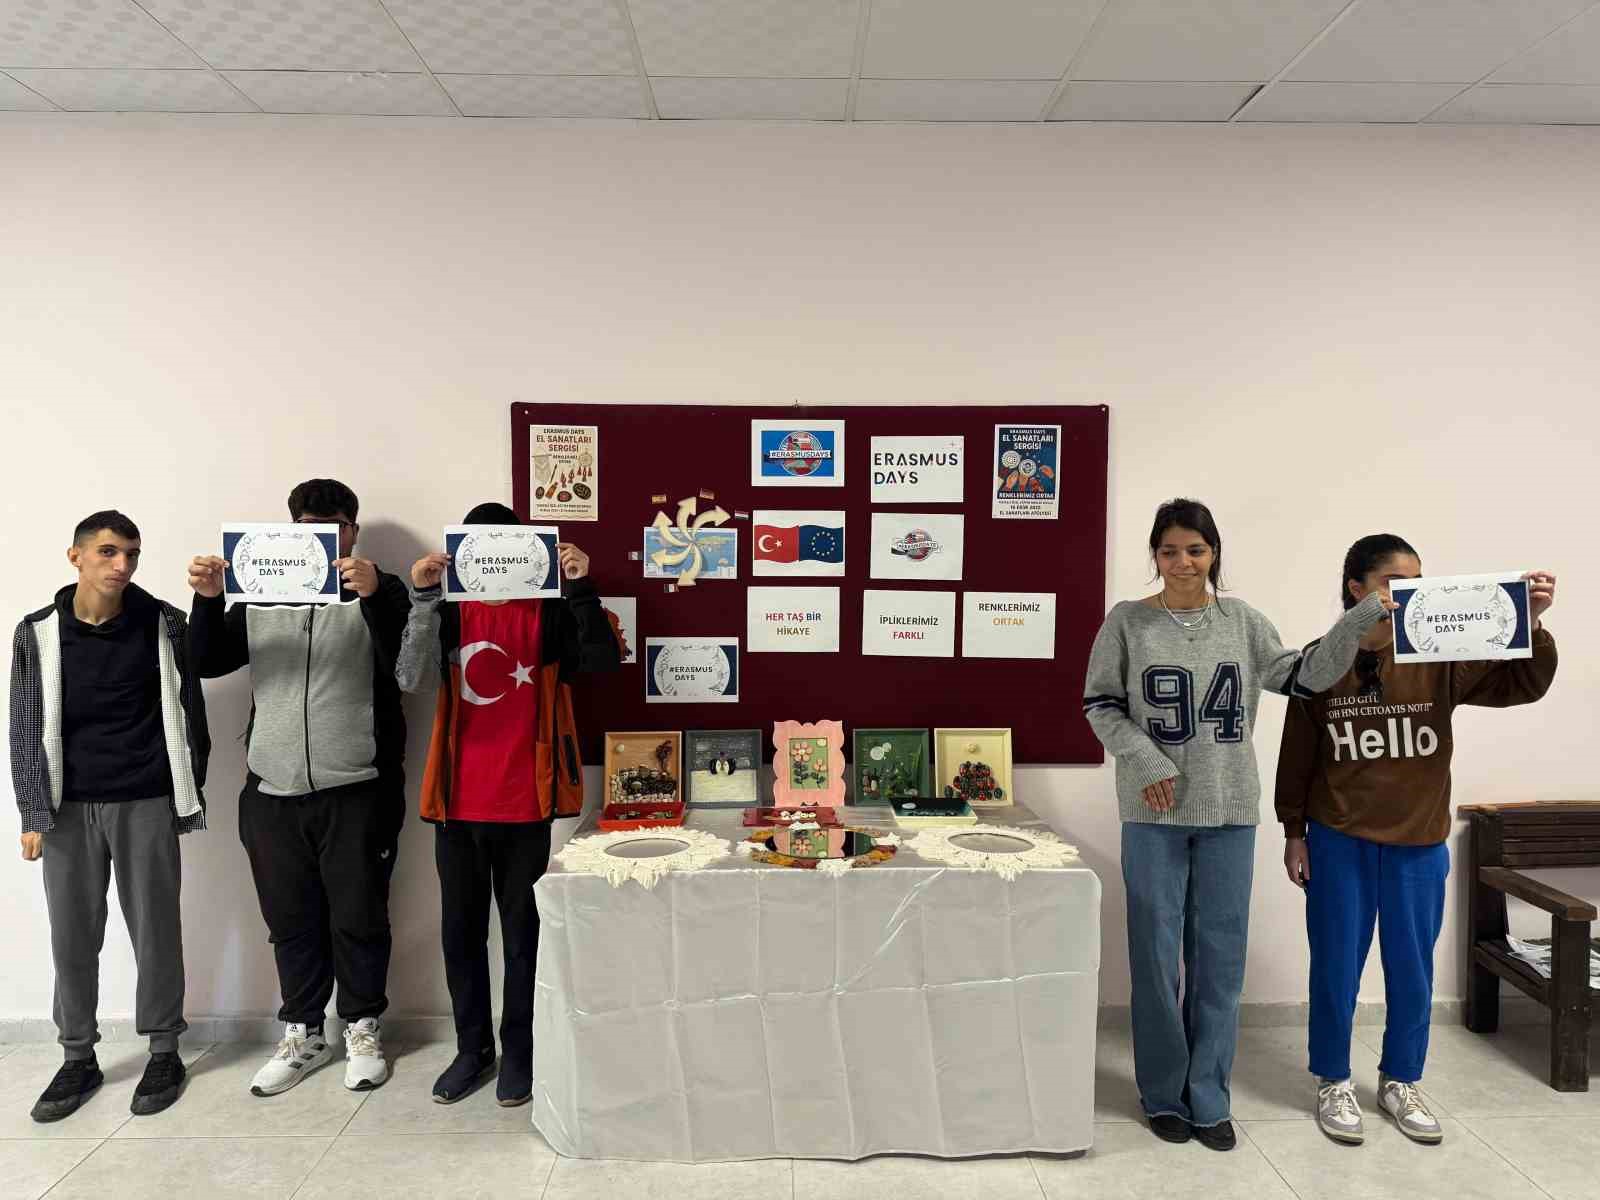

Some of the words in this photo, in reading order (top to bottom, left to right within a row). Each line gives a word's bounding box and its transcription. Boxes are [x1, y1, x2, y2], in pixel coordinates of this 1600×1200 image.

[874, 452, 959, 466] ERASMUS
[874, 471, 918, 484] DAYS
[475, 557, 529, 565] #ERASMUS
[482, 567, 508, 575] DAYS
[978, 602, 1040, 612] RENKLERİMİZ
[766, 612, 784, 620] HER
[787, 612, 804, 622] TAŞ
[806, 611, 822, 620] BİR
[880, 614, 938, 626] İPLİKLERİMİZ
[992, 617, 1024, 626] ORTAK
[1426, 612, 1490, 624] #ERASMUS
[776, 626, 810, 636] HİKAYE
[1436, 624, 1464, 633] DAYS
[893, 632, 924, 640] FARKLI
[1142, 662, 1244, 744] 94
[1327, 717, 1438, 761] Hello
